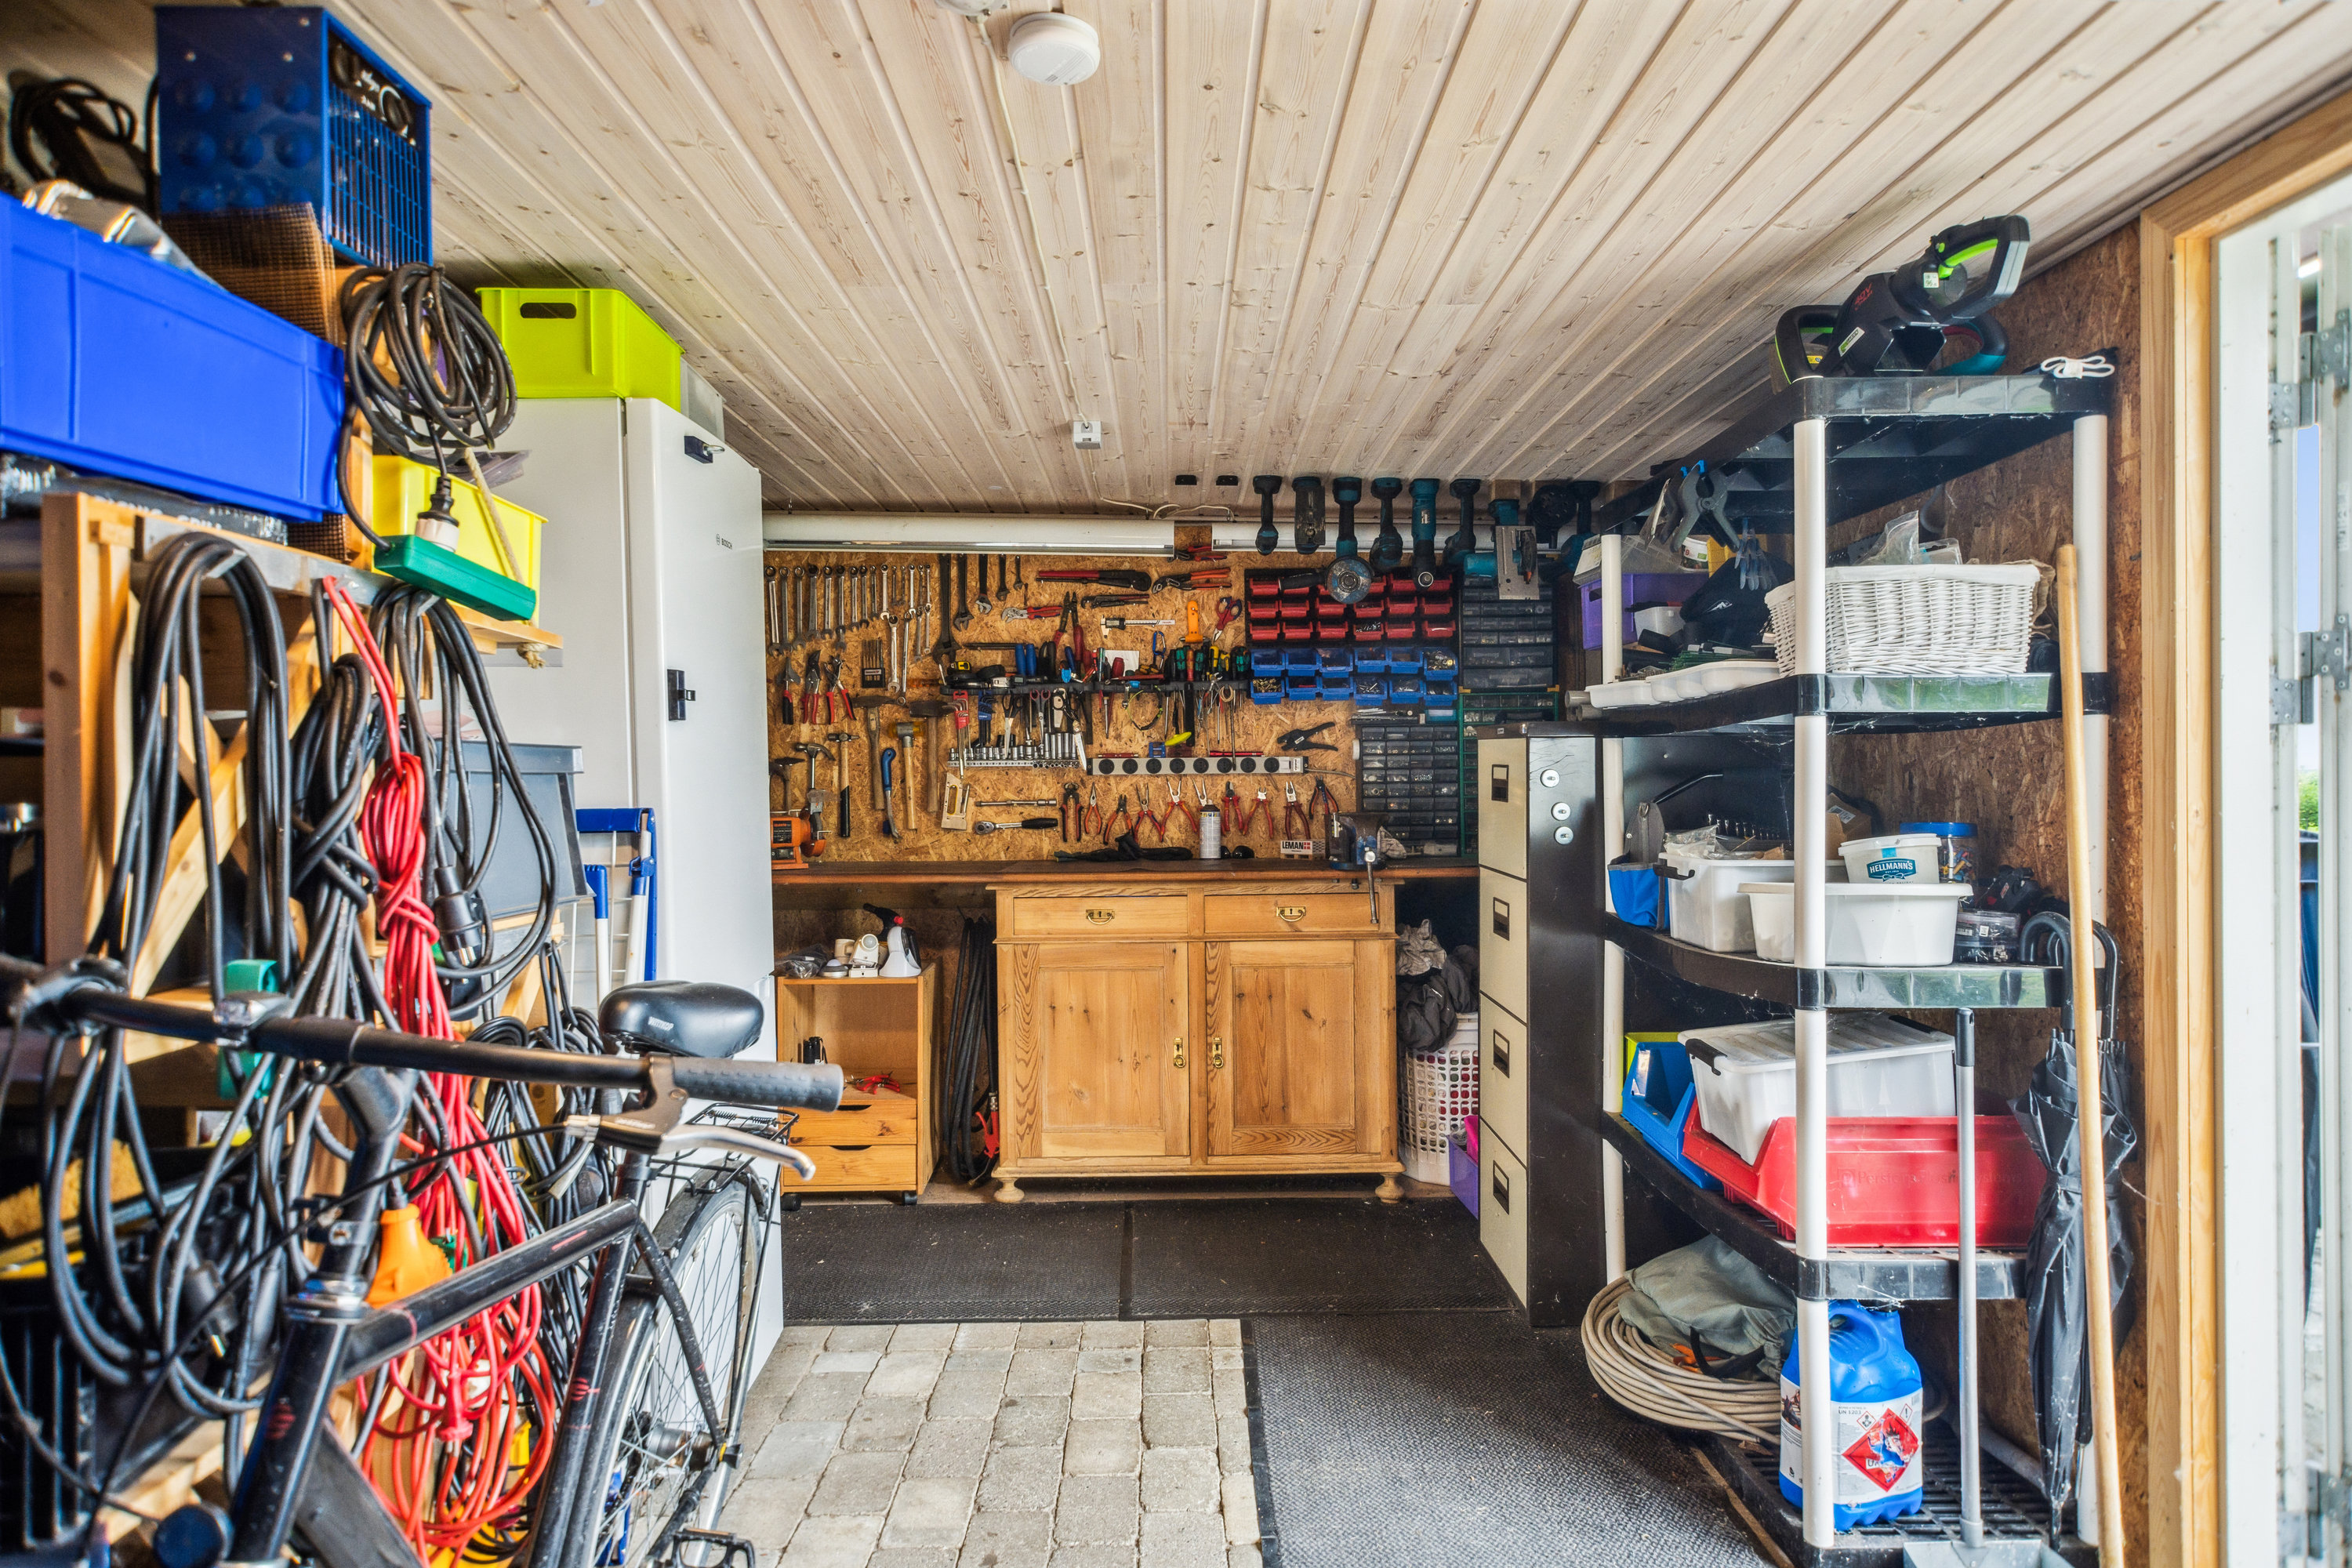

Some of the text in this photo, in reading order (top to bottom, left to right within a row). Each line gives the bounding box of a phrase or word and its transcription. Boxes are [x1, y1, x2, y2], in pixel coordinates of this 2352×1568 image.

[721, 538, 733, 550] BOSCH
[1282, 841, 1304, 850] LEMAN
[1870, 861, 1913, 873] HELLMANN'S
